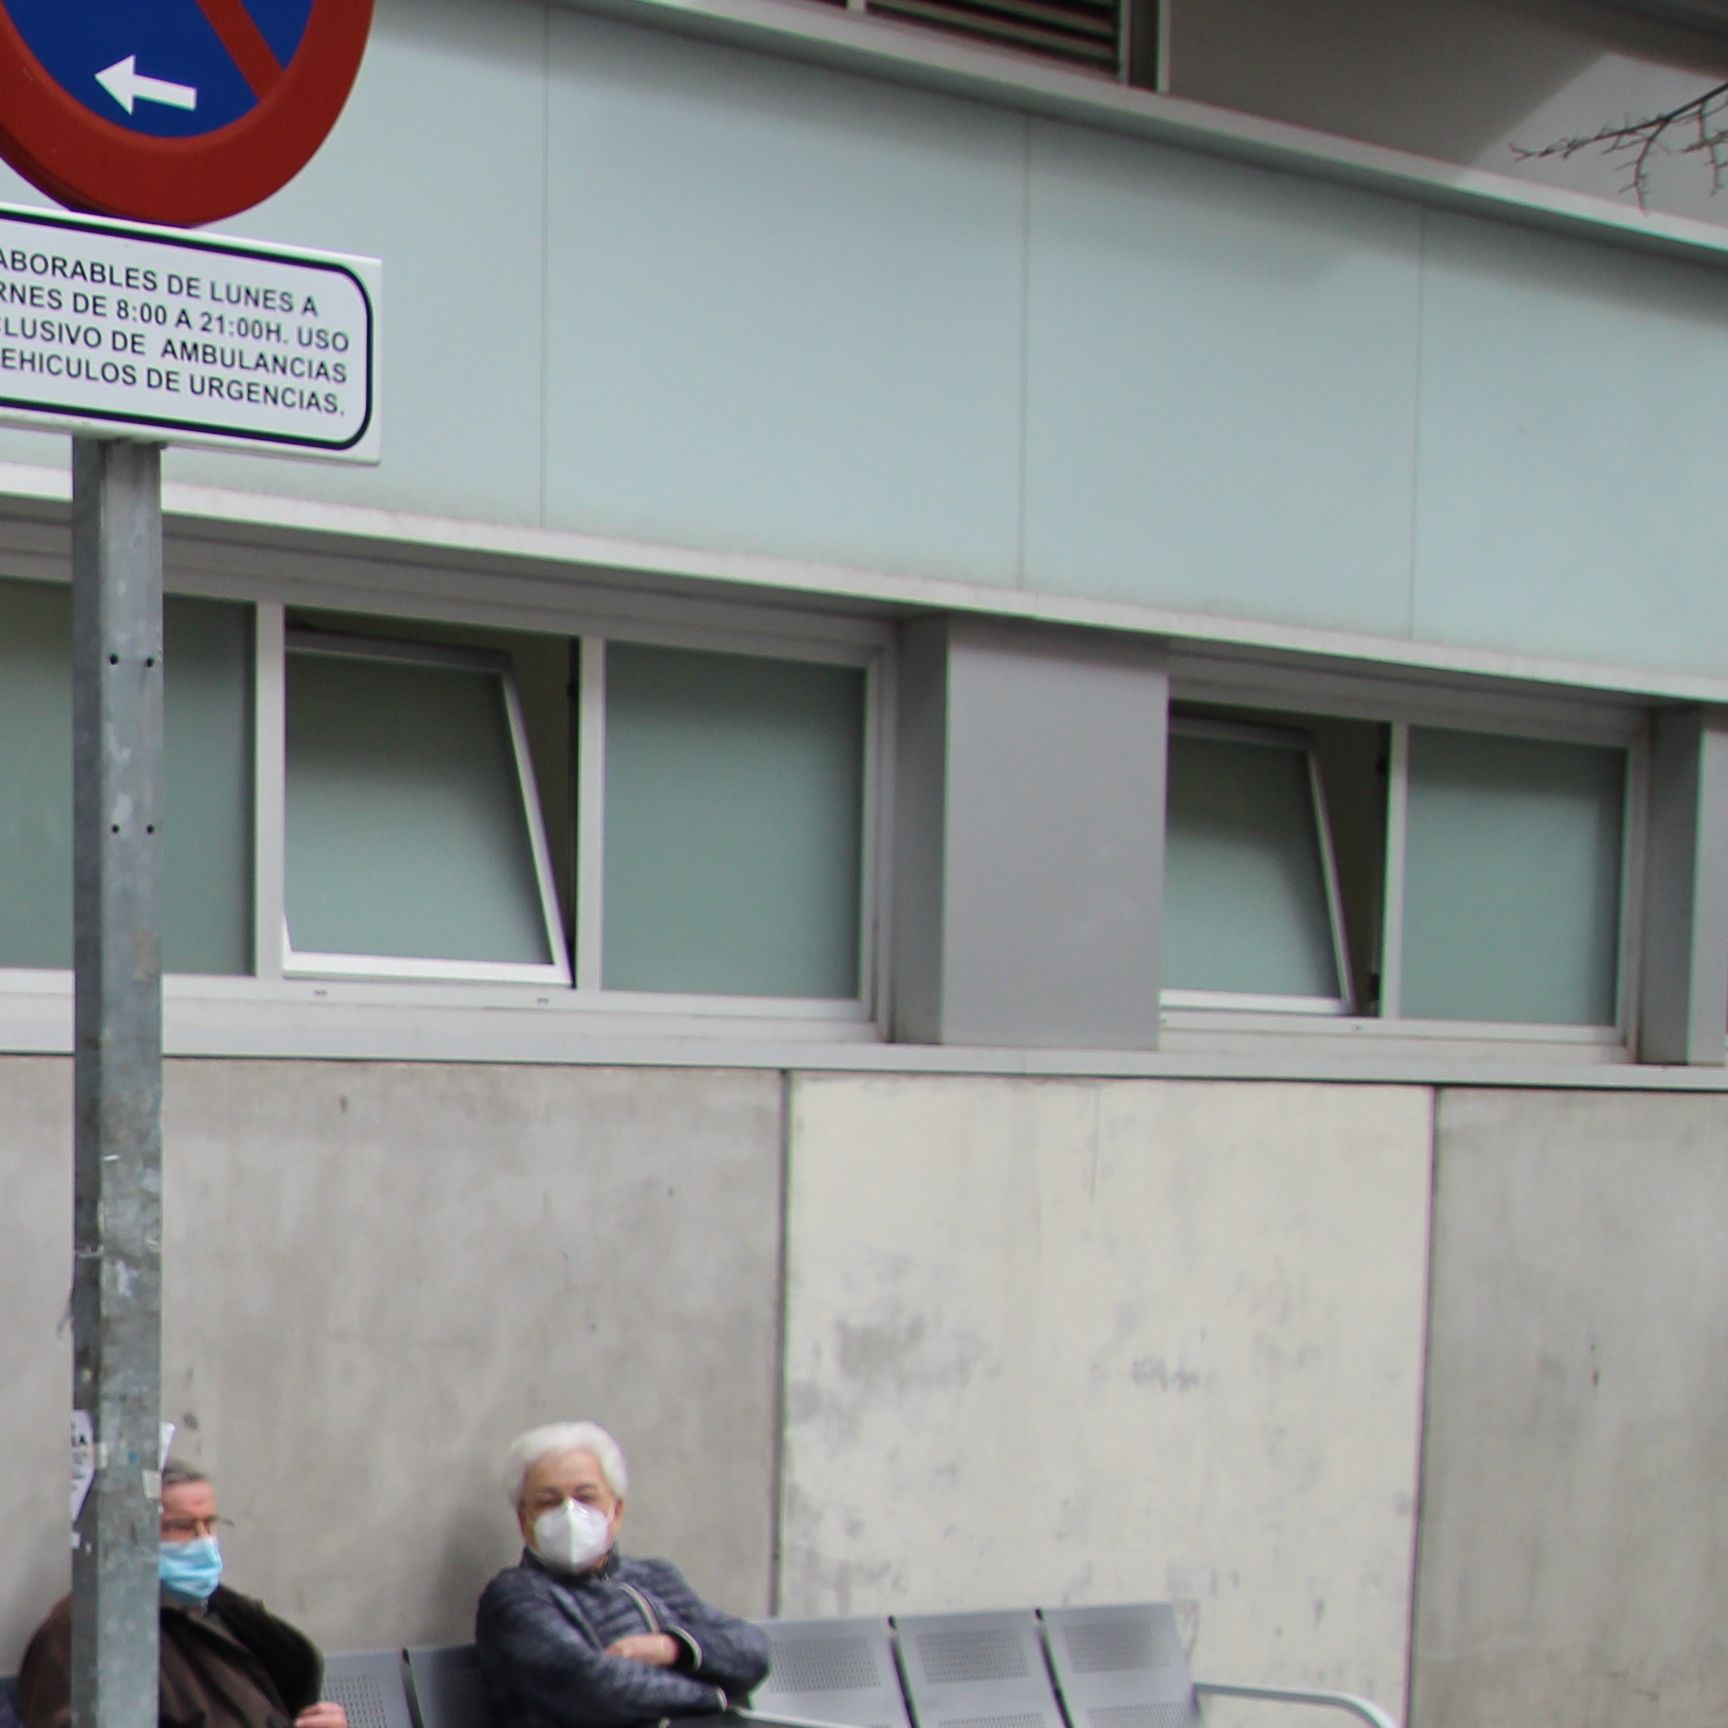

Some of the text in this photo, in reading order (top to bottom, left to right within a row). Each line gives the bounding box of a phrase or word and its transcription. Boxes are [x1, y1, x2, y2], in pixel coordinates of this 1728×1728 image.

[167, 274, 200, 297] DE
[210, 280, 293, 312] LUNES
[301, 296, 318, 316] A
[73, 292, 107, 315] DE
[116, 299, 167, 324] 8:00
[174, 309, 192, 329] A
[200, 312, 289, 343] 21:00H.
[298, 327, 349, 351] USO
[112, 331, 145, 354] DE
[161, 339, 347, 383] AMBULANCIAS
[147, 368, 180, 391] DE
[190, 374, 345, 415] URGENCIAS.
